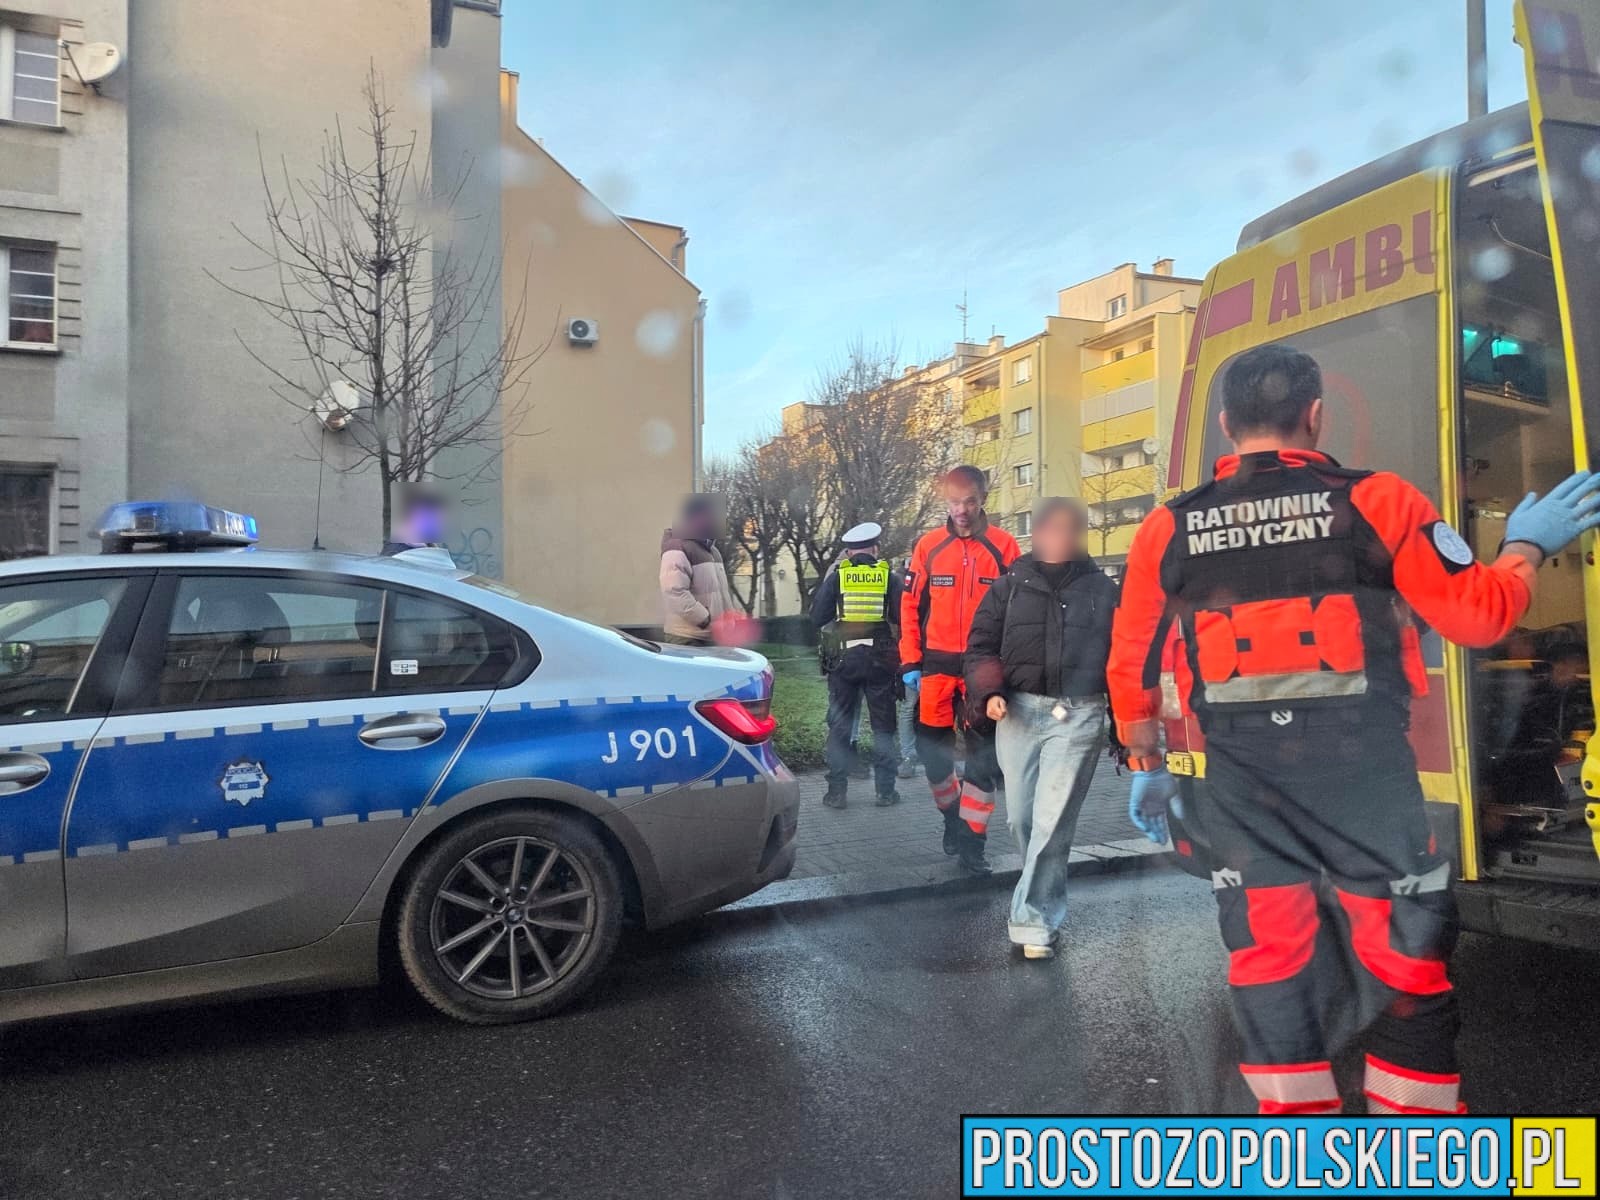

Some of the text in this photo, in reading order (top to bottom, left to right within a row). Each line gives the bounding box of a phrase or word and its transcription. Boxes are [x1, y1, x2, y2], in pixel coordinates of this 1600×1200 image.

[1186, 491, 1333, 532] RATOWNIK
[1188, 515, 1335, 555] MEDYCZNY
[846, 573, 883, 583] POLICJA
[601, 725, 697, 764] J 901
